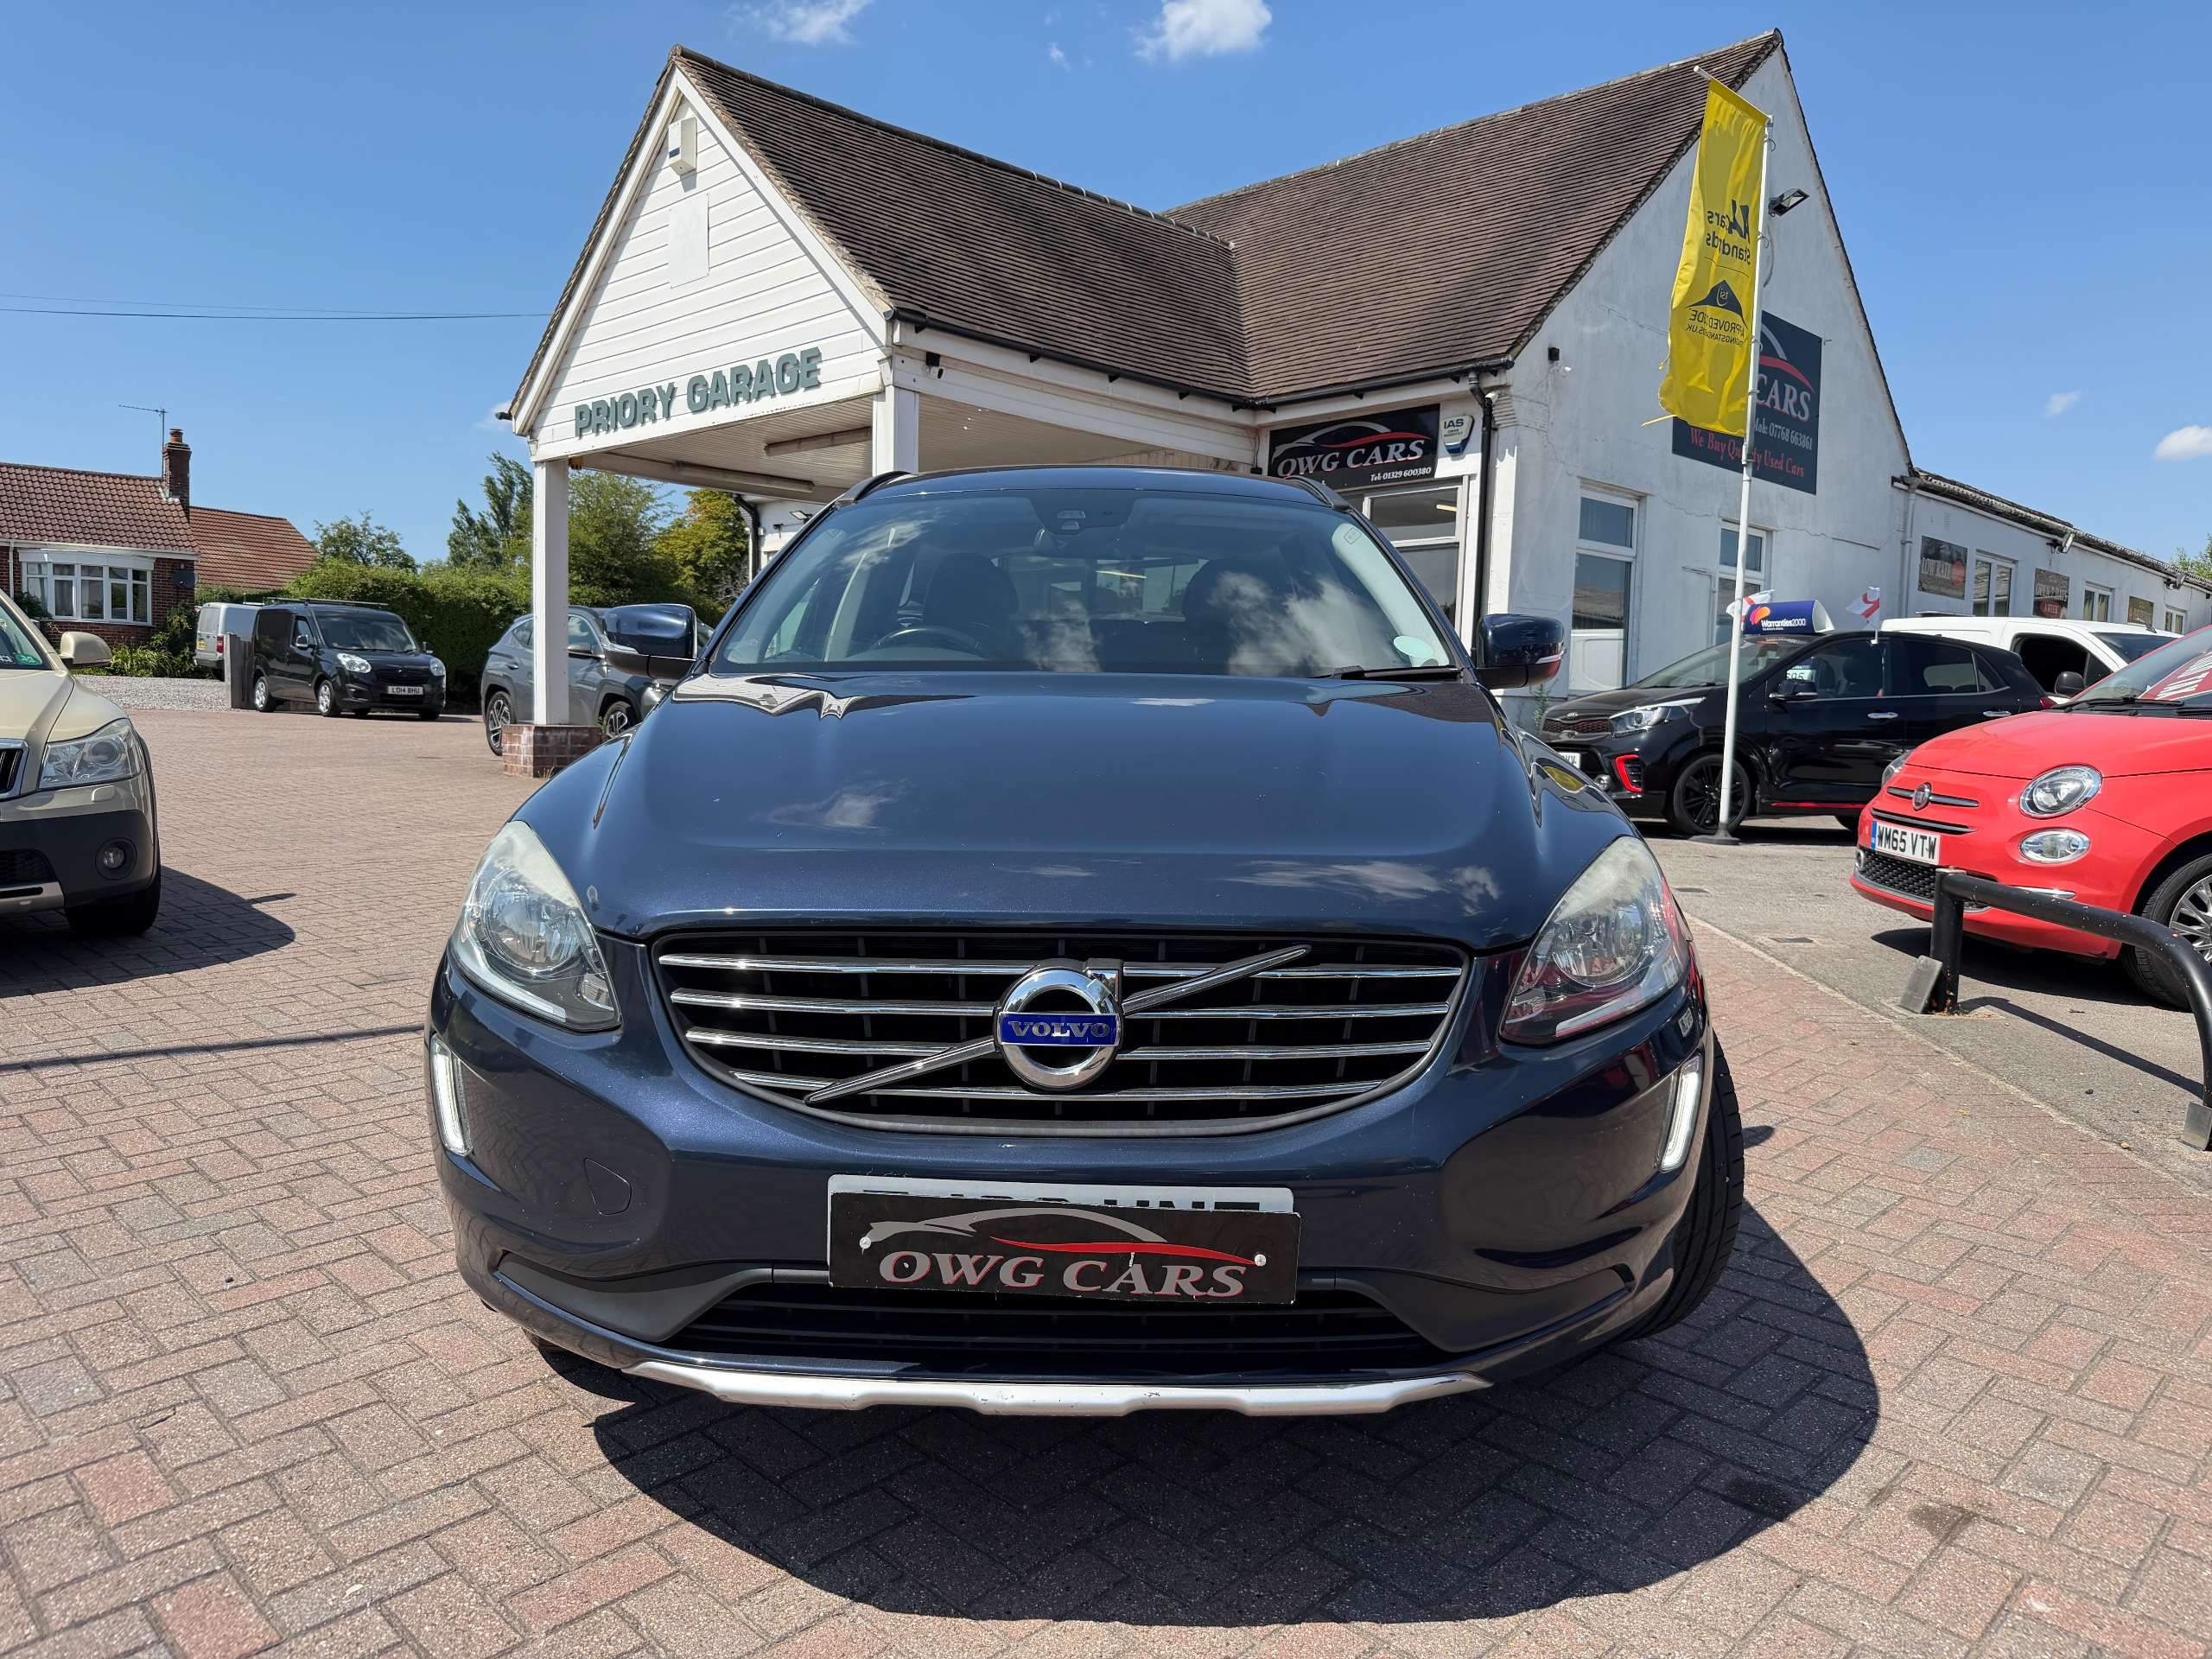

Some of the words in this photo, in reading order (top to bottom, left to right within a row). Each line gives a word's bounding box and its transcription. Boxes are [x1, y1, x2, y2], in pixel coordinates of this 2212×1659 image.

[575, 381, 677, 440] PRIORY
[686, 346, 822, 414] GARAGE
[1444, 418, 1465, 429] IAS
[1769, 423, 1789, 442] 07768
[1277, 452, 1340, 477] OWG
[1346, 439, 1425, 468] CARS
[1690, 427, 1704, 447] We
[1707, 433, 1726, 461] Buy
[1764, 449, 1783, 472] Used
[1785, 458, 1805, 478] Cars
[1382, 471, 1402, 480] 01329
[1403, 467, 1432, 479] 600380
[1761, 618, 1807, 628] Warranties2000
[1878, 825, 1907, 853] WM65
[1910, 832, 1937, 860] VTW
[1007, 1020, 1110, 1038] VOLVO
[879, 1250, 1044, 1287] OWG
[1062, 1259, 1249, 1298] CARS
